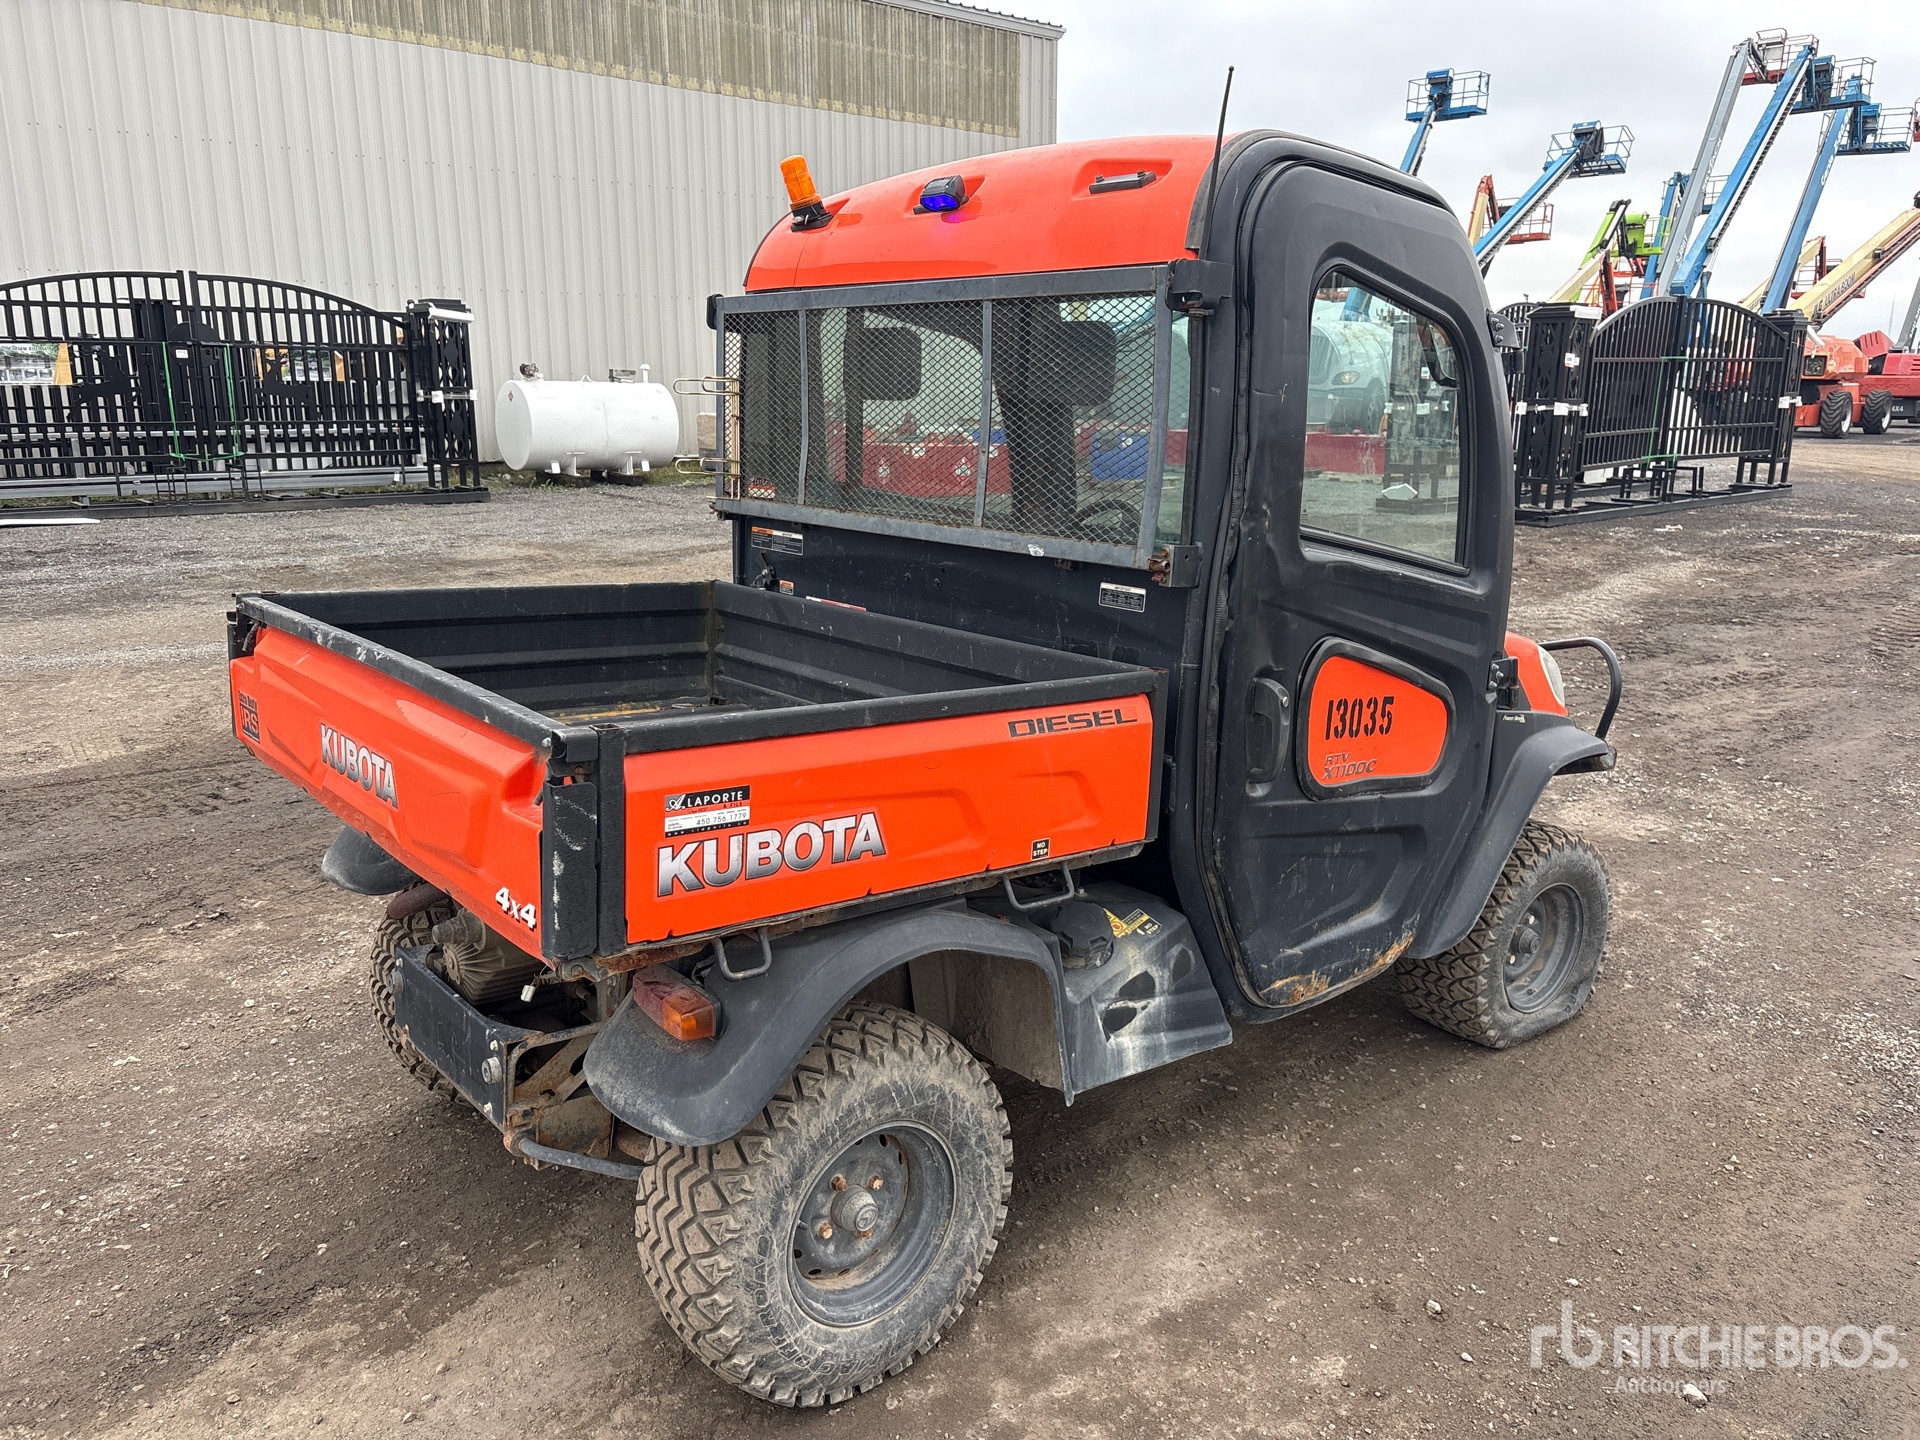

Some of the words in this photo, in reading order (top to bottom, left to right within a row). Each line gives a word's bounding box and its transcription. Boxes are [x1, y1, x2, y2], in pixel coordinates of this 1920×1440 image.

[1008, 708, 1138, 738] DIESEL
[1325, 696, 1395, 740] 13035
[320, 722, 399, 809] KUBOTA
[1325, 752, 1351, 766] RTV
[1322, 759, 1377, 780] X1100C
[687, 791, 744, 807] LAPORTE
[696, 812, 747, 826] 450.756.1779
[1032, 848, 1048, 857] STEP
[1036, 841, 1046, 849] NO
[656, 811, 887, 898] KUBOTA
